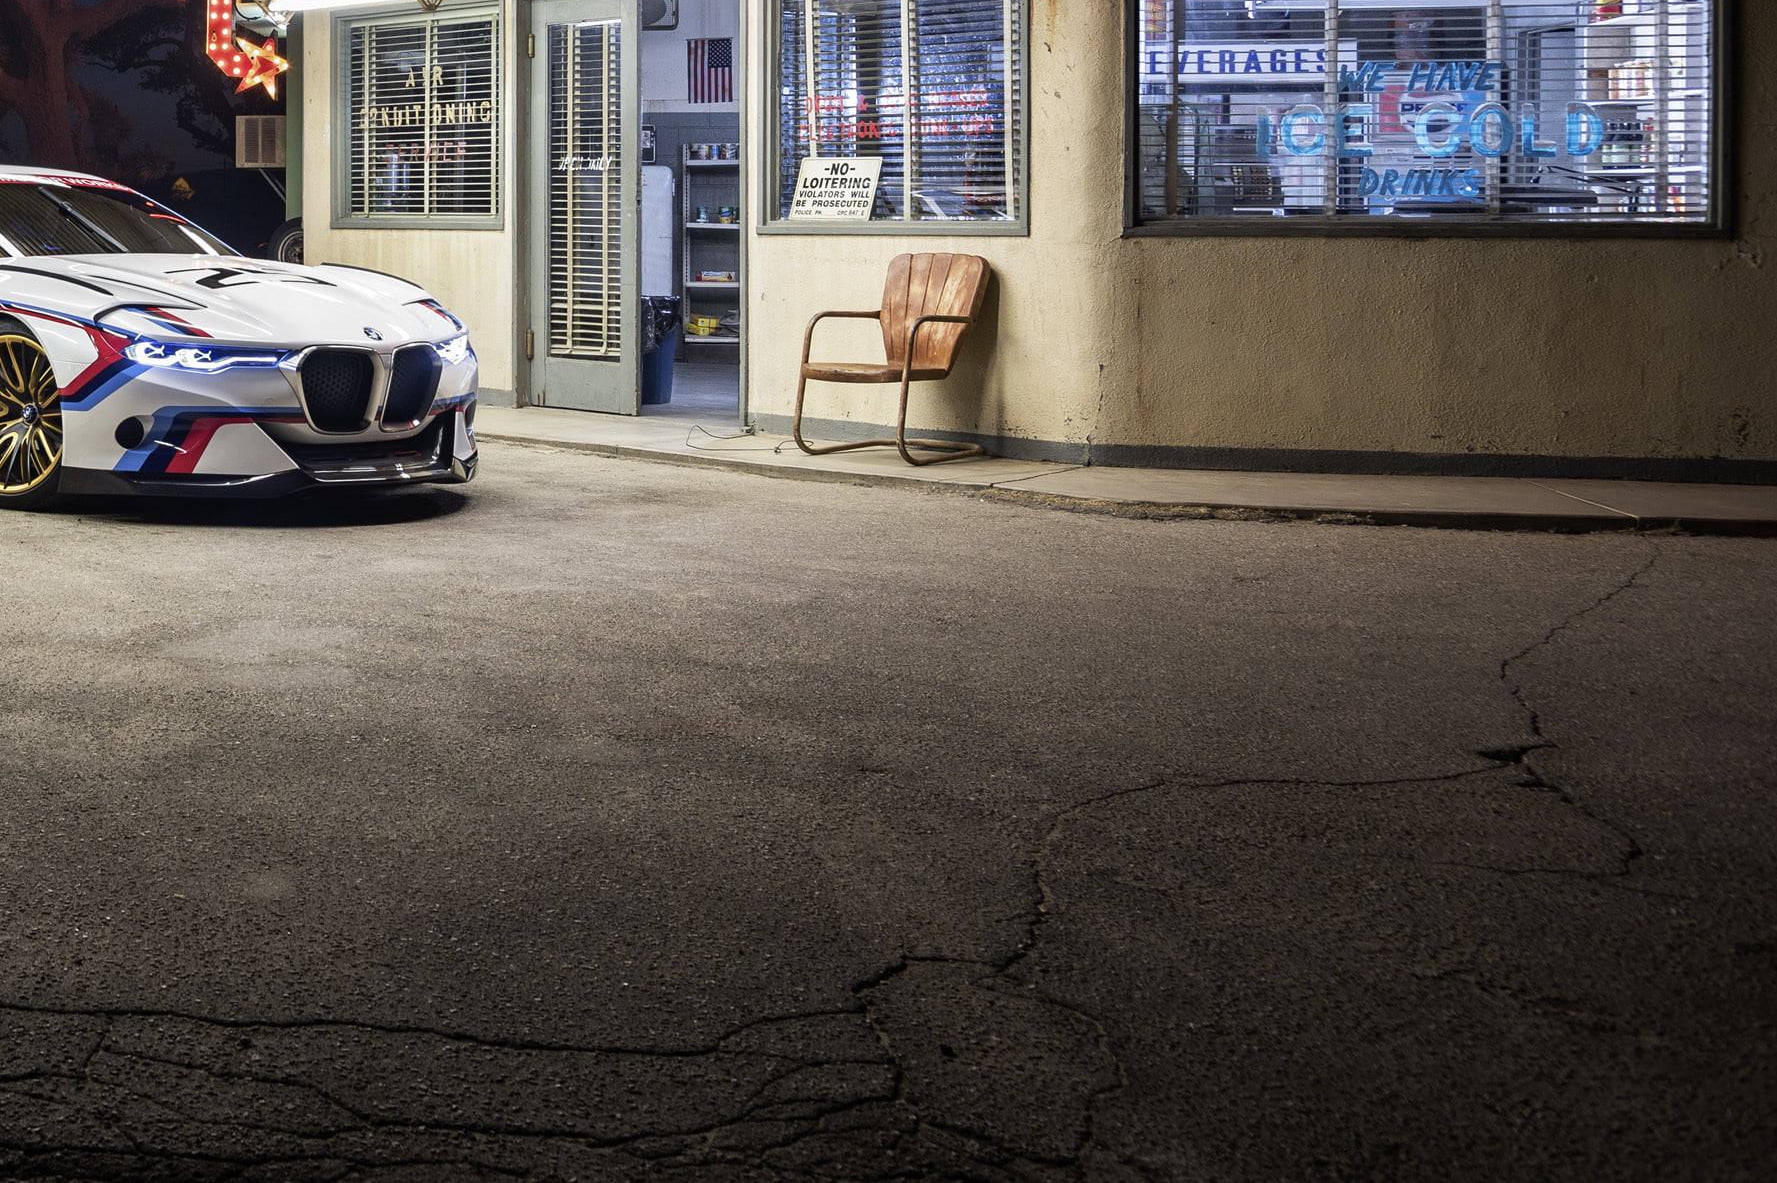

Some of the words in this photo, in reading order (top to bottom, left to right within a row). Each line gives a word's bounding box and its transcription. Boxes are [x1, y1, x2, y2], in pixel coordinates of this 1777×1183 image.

[1337, 61, 1397, 92] WE
[1408, 61, 1505, 92] HAVE
[358, 101, 492, 129] CONDITONING
[1256, 103, 1374, 158] ICE
[1414, 101, 1604, 158] COLD
[799, 190, 845, 198] VIOLATORS
[851, 190, 870, 198] WILL
[803, 177, 871, 189] LOITERING
[1357, 168, 1480, 196] DRINKS
[795, 199, 806, 207] BE
[812, 199, 869, 208] PROSECUTED
